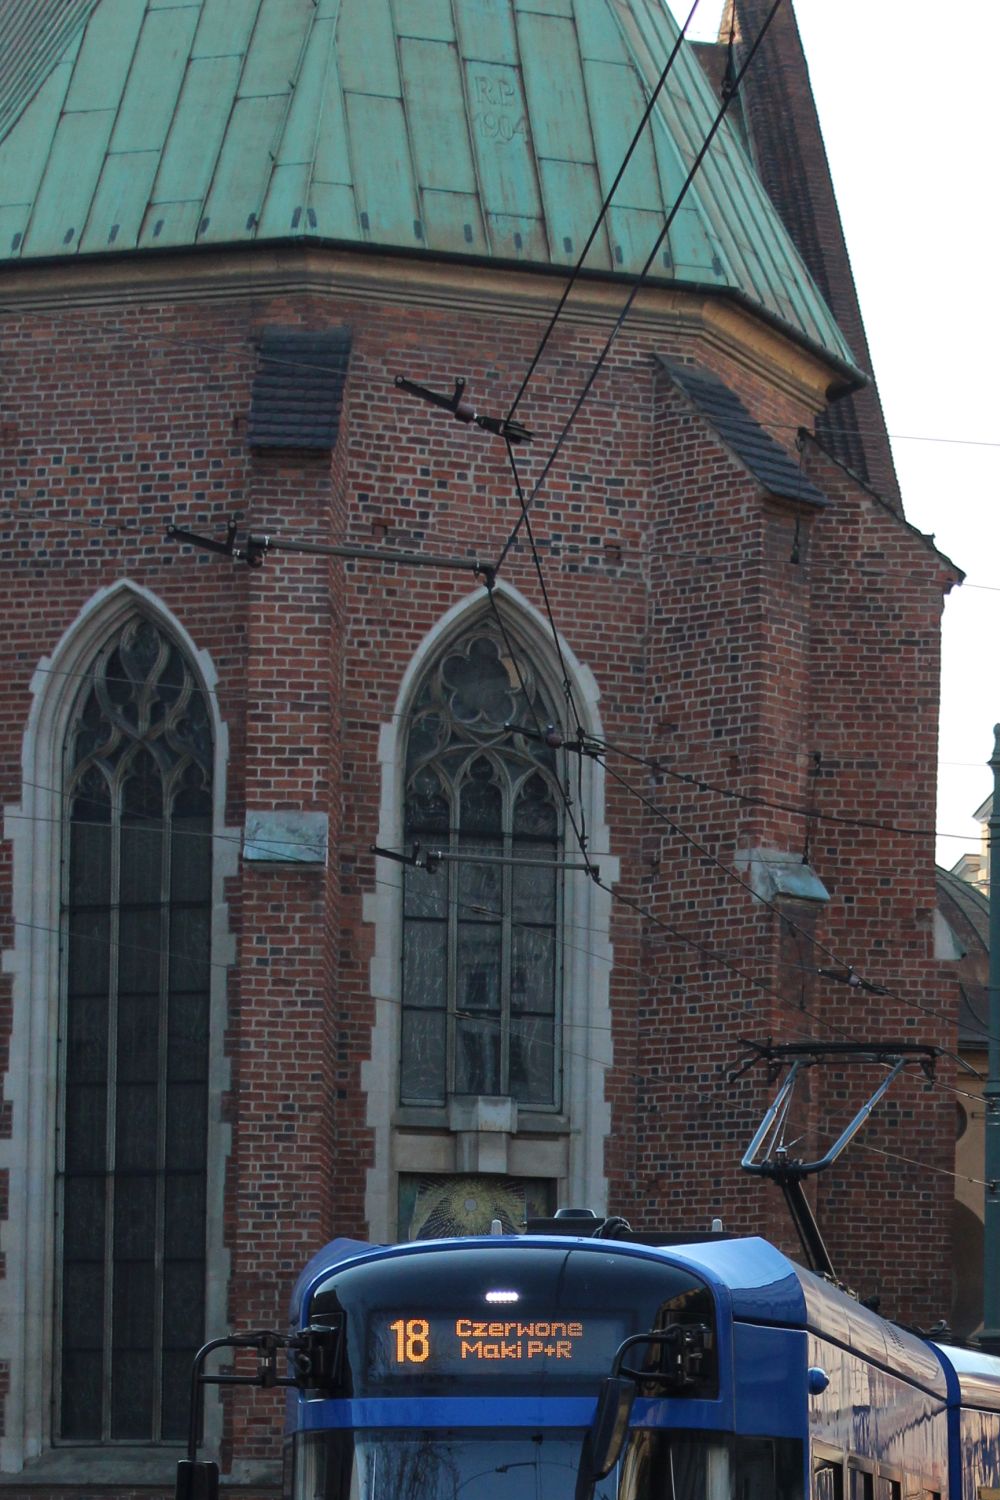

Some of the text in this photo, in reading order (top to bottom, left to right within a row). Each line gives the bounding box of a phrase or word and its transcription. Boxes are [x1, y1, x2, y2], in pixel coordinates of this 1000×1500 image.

[455, 1318, 583, 1338] Czerwone
[389, 1318, 430, 1363] 18
[460, 1340, 573, 1360] Maki P+R
